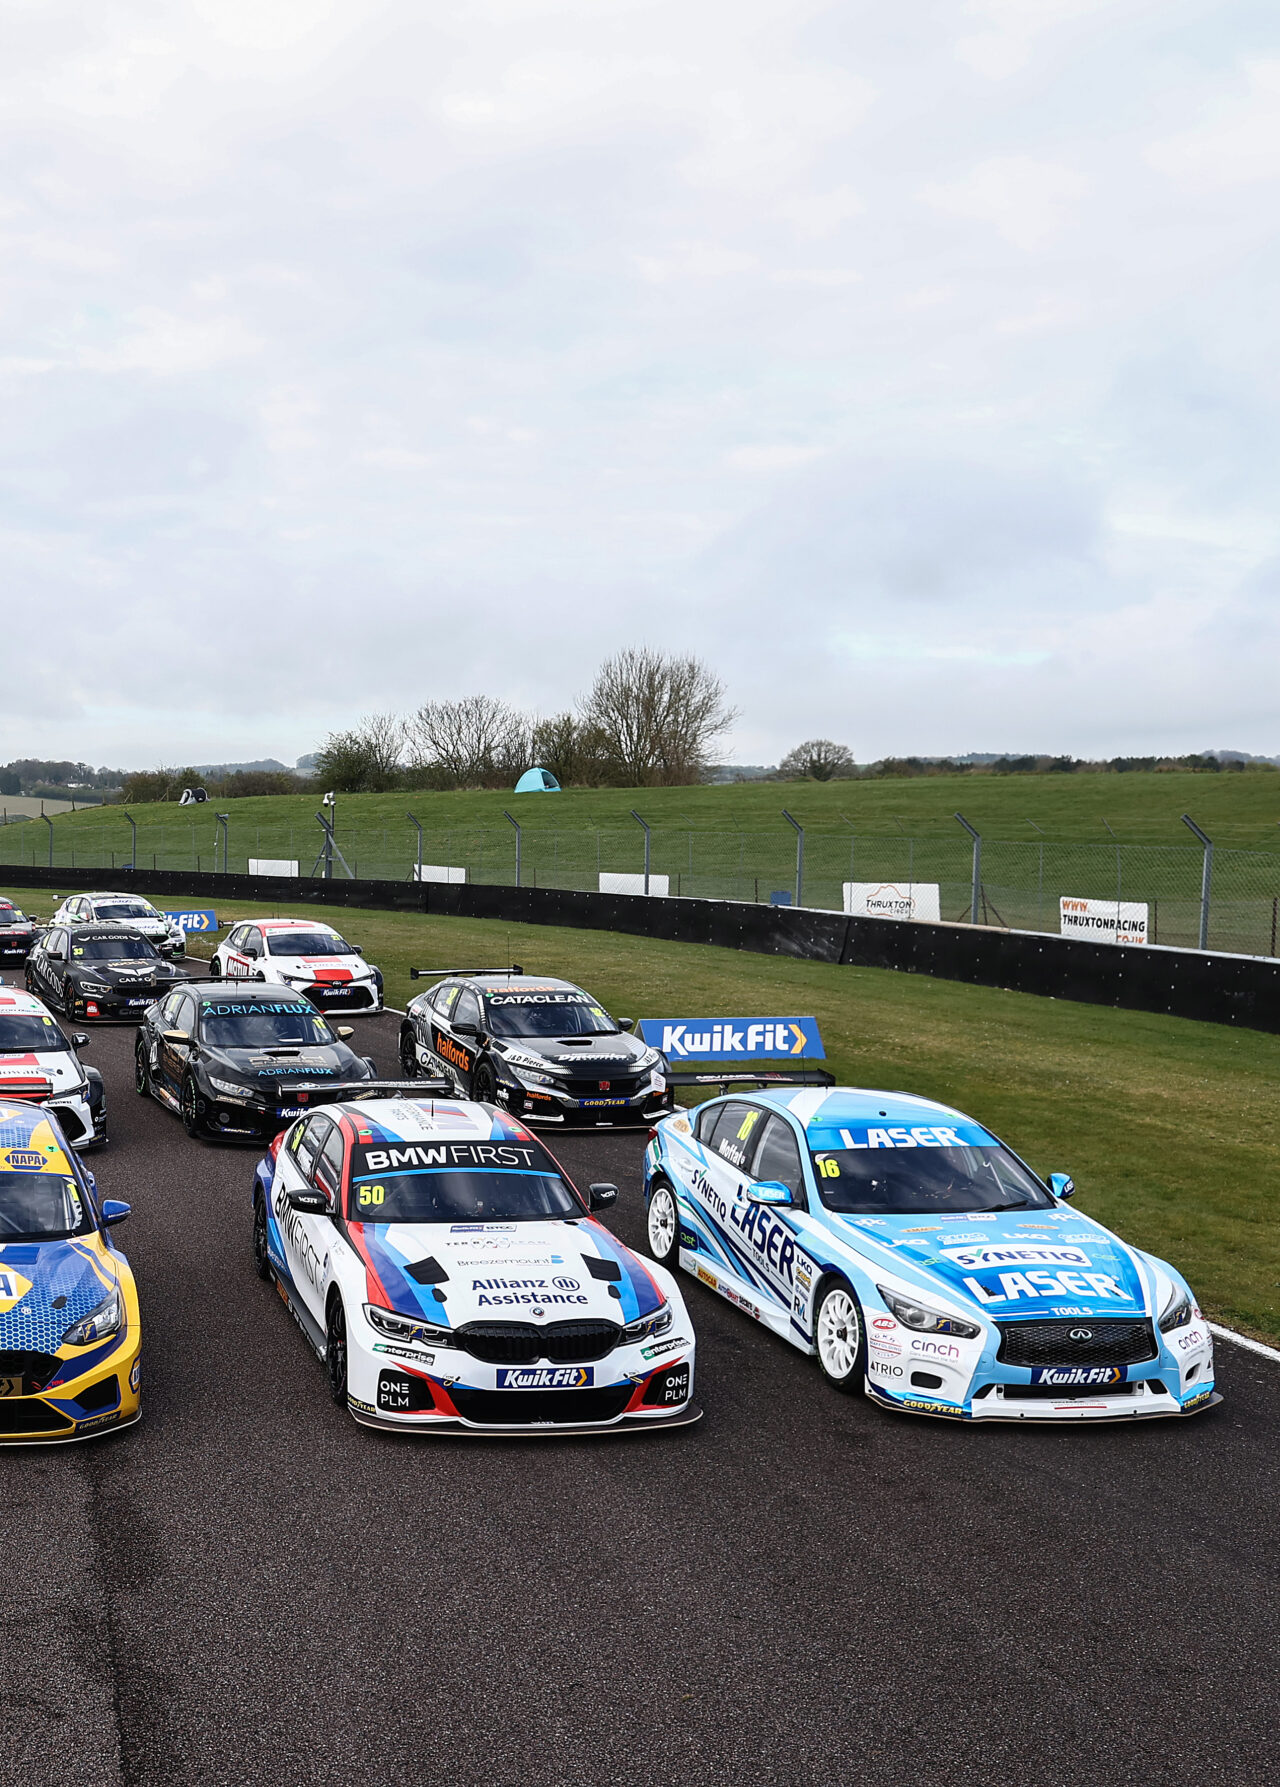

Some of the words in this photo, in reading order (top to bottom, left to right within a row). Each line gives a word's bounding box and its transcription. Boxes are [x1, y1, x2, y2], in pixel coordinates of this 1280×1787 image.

[866, 900, 912, 910] THRUXTON
[1062, 914, 1146, 933] THRUXTONRACING
[490, 994, 590, 1005] CATACLEAN
[436, 1031, 470, 1072] halfords
[522, 1057, 543, 1068] Pierce
[526, 1091, 552, 1101] halfords
[584, 1098, 626, 1107] GOODYEAR
[736, 1110, 759, 1141] 16
[840, 1126, 970, 1149] LASER
[11, 1155, 43, 1166] NAPA
[719, 1138, 743, 1167] Moffat
[817, 1159, 840, 1178] 16
[359, 1185, 384, 1206] 50
[691, 1168, 727, 1222] SYNETIQ
[730, 1183, 795, 1287] LASER
[882, 1238, 931, 1248] LKQ
[1002, 1232, 1052, 1240] LKQ
[457, 1257, 550, 1266] Breezemount
[752, 1249, 770, 1273] TOOLS
[957, 1248, 1086, 1266] SYNETIQ
[796, 1255, 812, 1276] LKQ
[471, 1278, 548, 1291] Allianz
[697, 1266, 717, 1290] AUTOCAR
[963, 1270, 1136, 1304] LASER
[478, 1291, 588, 1306] Assistance
[1050, 1306, 1094, 1316] TOOLS
[874, 1320, 895, 1328] ABS
[1178, 1328, 1203, 1349] cinch
[375, 1344, 434, 1362] enterprise
[644, 1338, 689, 1359] enterprise
[911, 1337, 959, 1358] cinch
[380, 1381, 410, 1393] ONE
[666, 1374, 688, 1388] ONE
[380, 1393, 409, 1407] PLM
[665, 1387, 687, 1401] PLM
[1184, 1391, 1211, 1408] GOODYEAR
[903, 1399, 963, 1415] GOODYEAR
[79, 1413, 118, 1429] GOODYEAR
